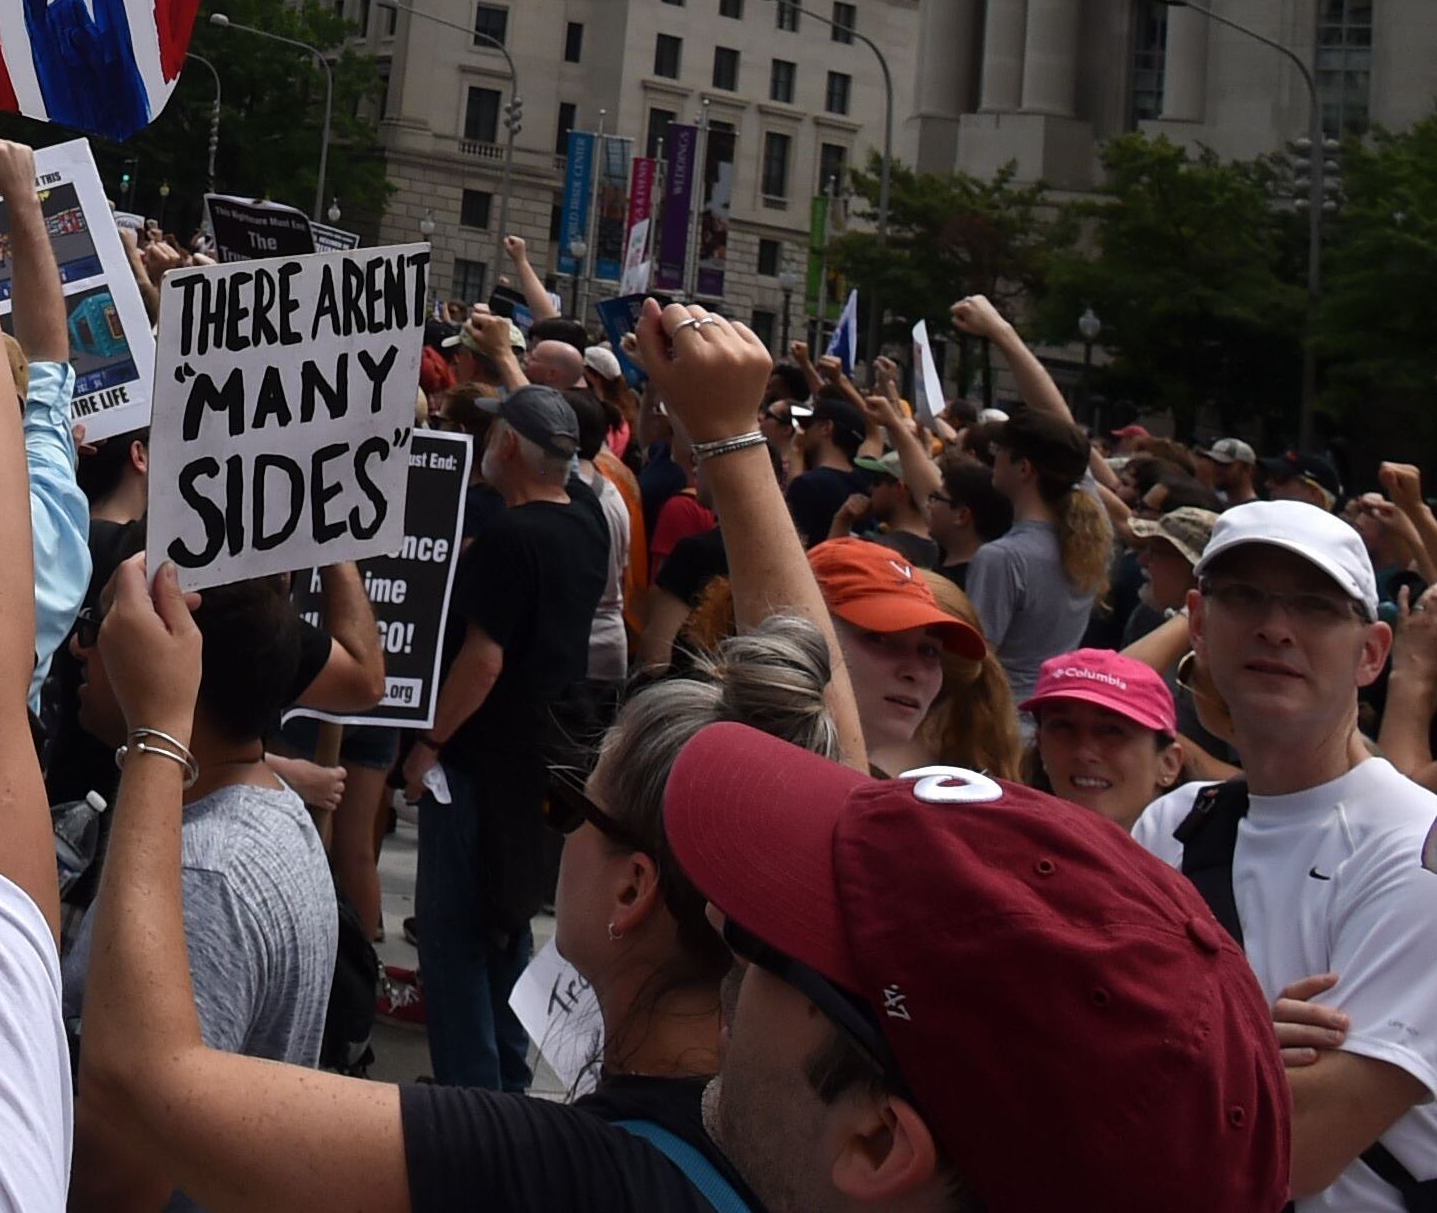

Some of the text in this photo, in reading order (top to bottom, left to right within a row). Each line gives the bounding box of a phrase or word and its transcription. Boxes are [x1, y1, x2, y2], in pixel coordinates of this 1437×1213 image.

[40, 171, 62, 185] THIS
[247, 230, 277, 251] The
[171, 262, 303, 356] THERE
[99, 386, 130, 410] LIFE
[409, 452, 457, 471] ust End:
[1065, 667, 1127, 690] Columbia
